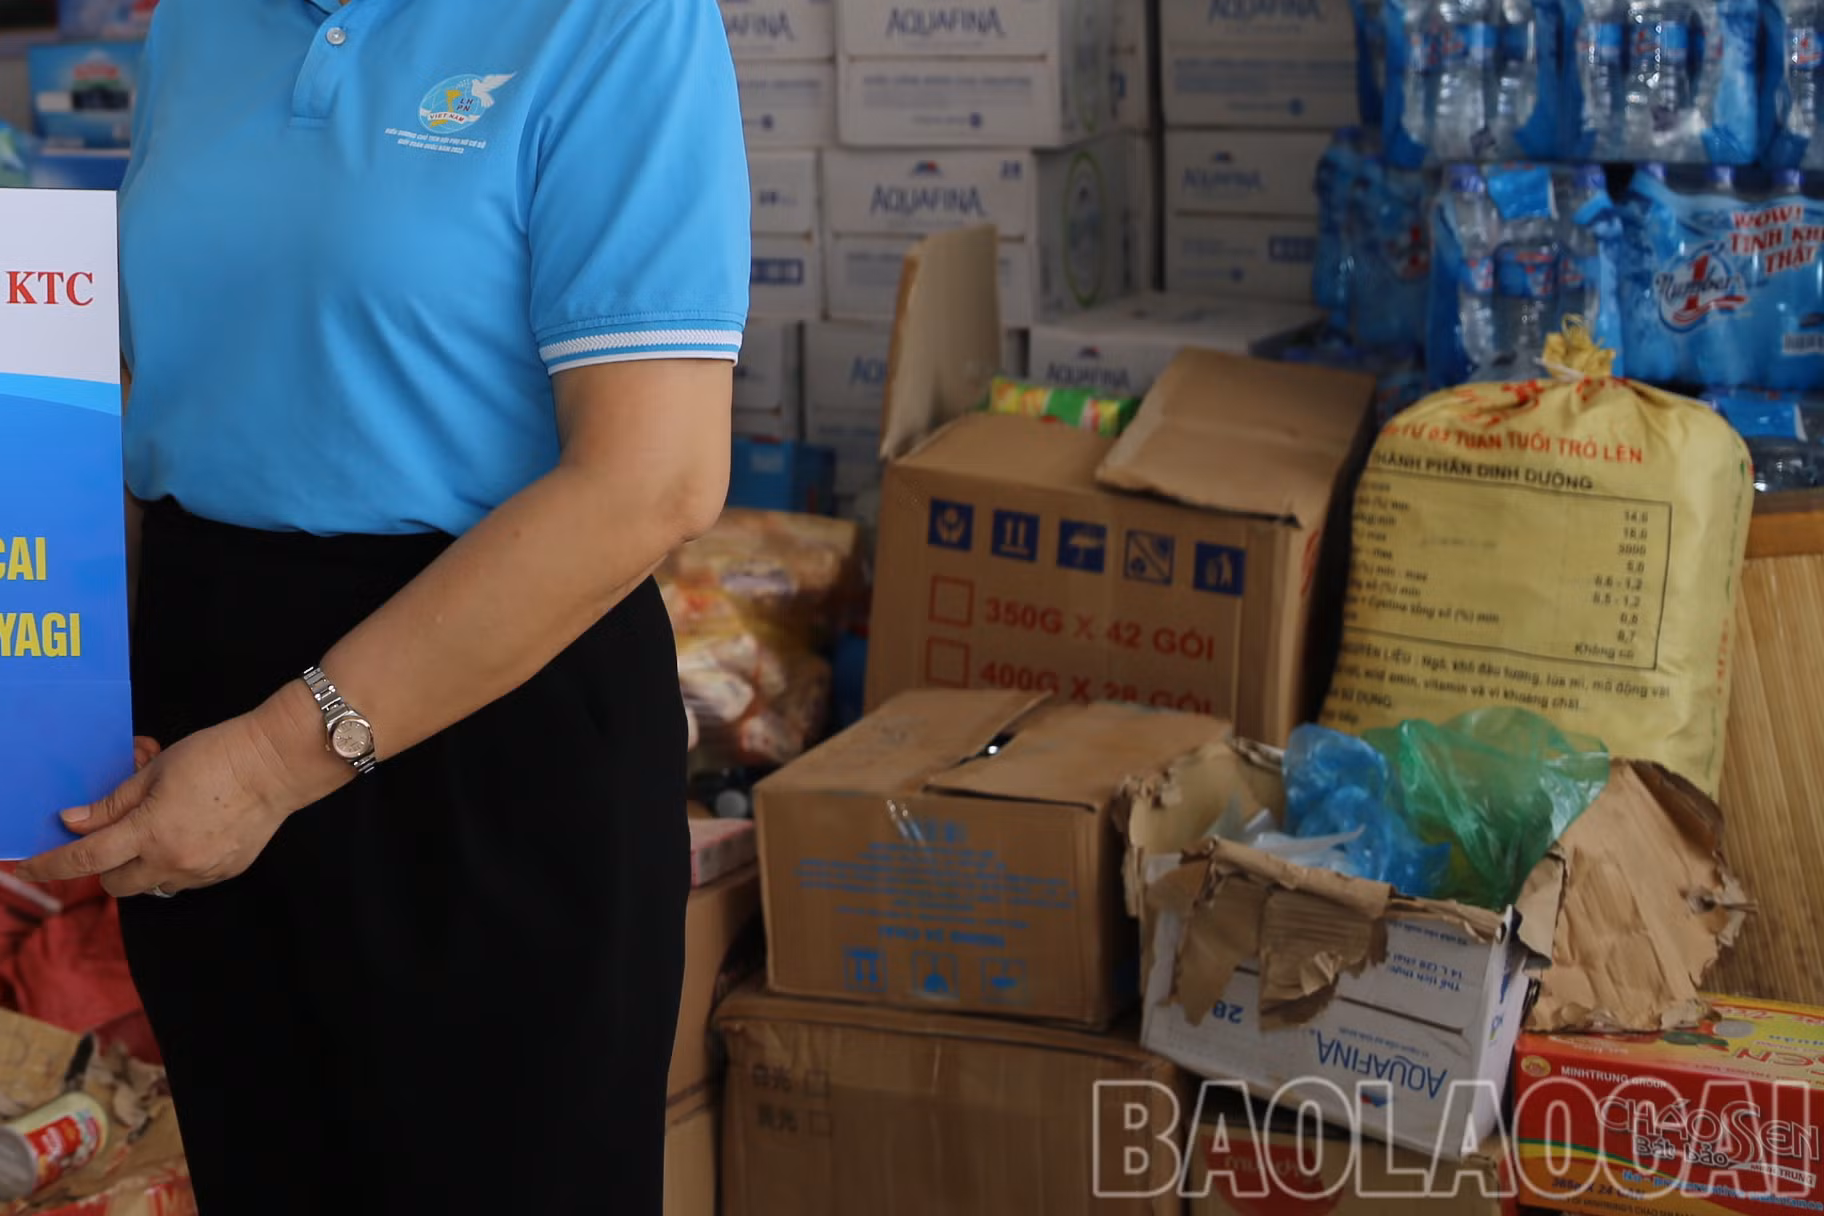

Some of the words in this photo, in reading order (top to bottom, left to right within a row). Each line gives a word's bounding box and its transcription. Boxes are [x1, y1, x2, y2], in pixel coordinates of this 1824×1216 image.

[885, 6, 1007, 39] AQUAFINA
[870, 185, 988, 216] AQUAFINA
[6, 271, 94, 307] KTC
[1046, 362, 1130, 387] AQUAFINA
[985, 596, 1065, 636] 350G
[1072, 613, 1097, 642] X
[1106, 620, 1143, 650] 42
[1152, 627, 1215, 662] GÓI
[1212, 999, 1244, 1025] 28
[1316, 1031, 1448, 1099] AQUAFINA
[1560, 1065, 1628, 1085] MINHTRUNG
